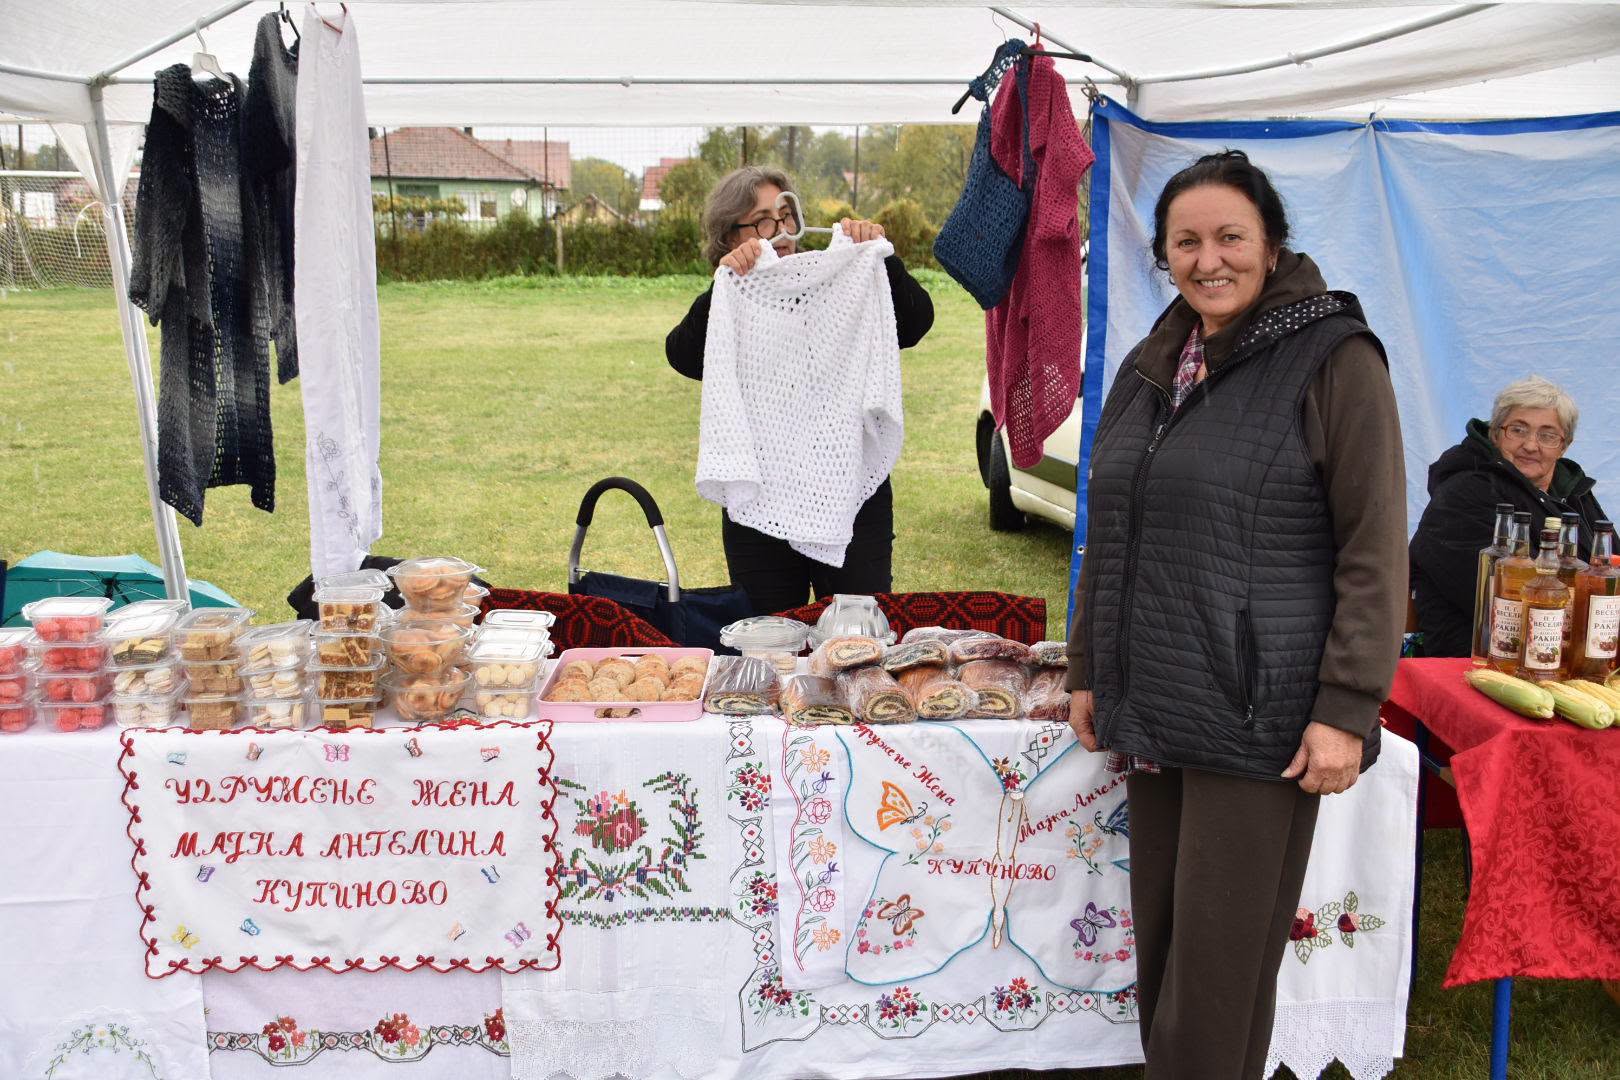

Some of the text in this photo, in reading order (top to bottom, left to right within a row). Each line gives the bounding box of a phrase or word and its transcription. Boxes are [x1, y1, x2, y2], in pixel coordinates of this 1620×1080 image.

[411, 778, 520, 807] ЖЕНА
[912, 764, 957, 807] Жена
[1018, 770, 1127, 843] Мајка Ангели
[170, 828, 507, 865] МАЈКА АНГЕЛИНА
[927, 857, 1057, 881] КУПИНОВО
[252, 878, 449, 913] КУПИНОВО
